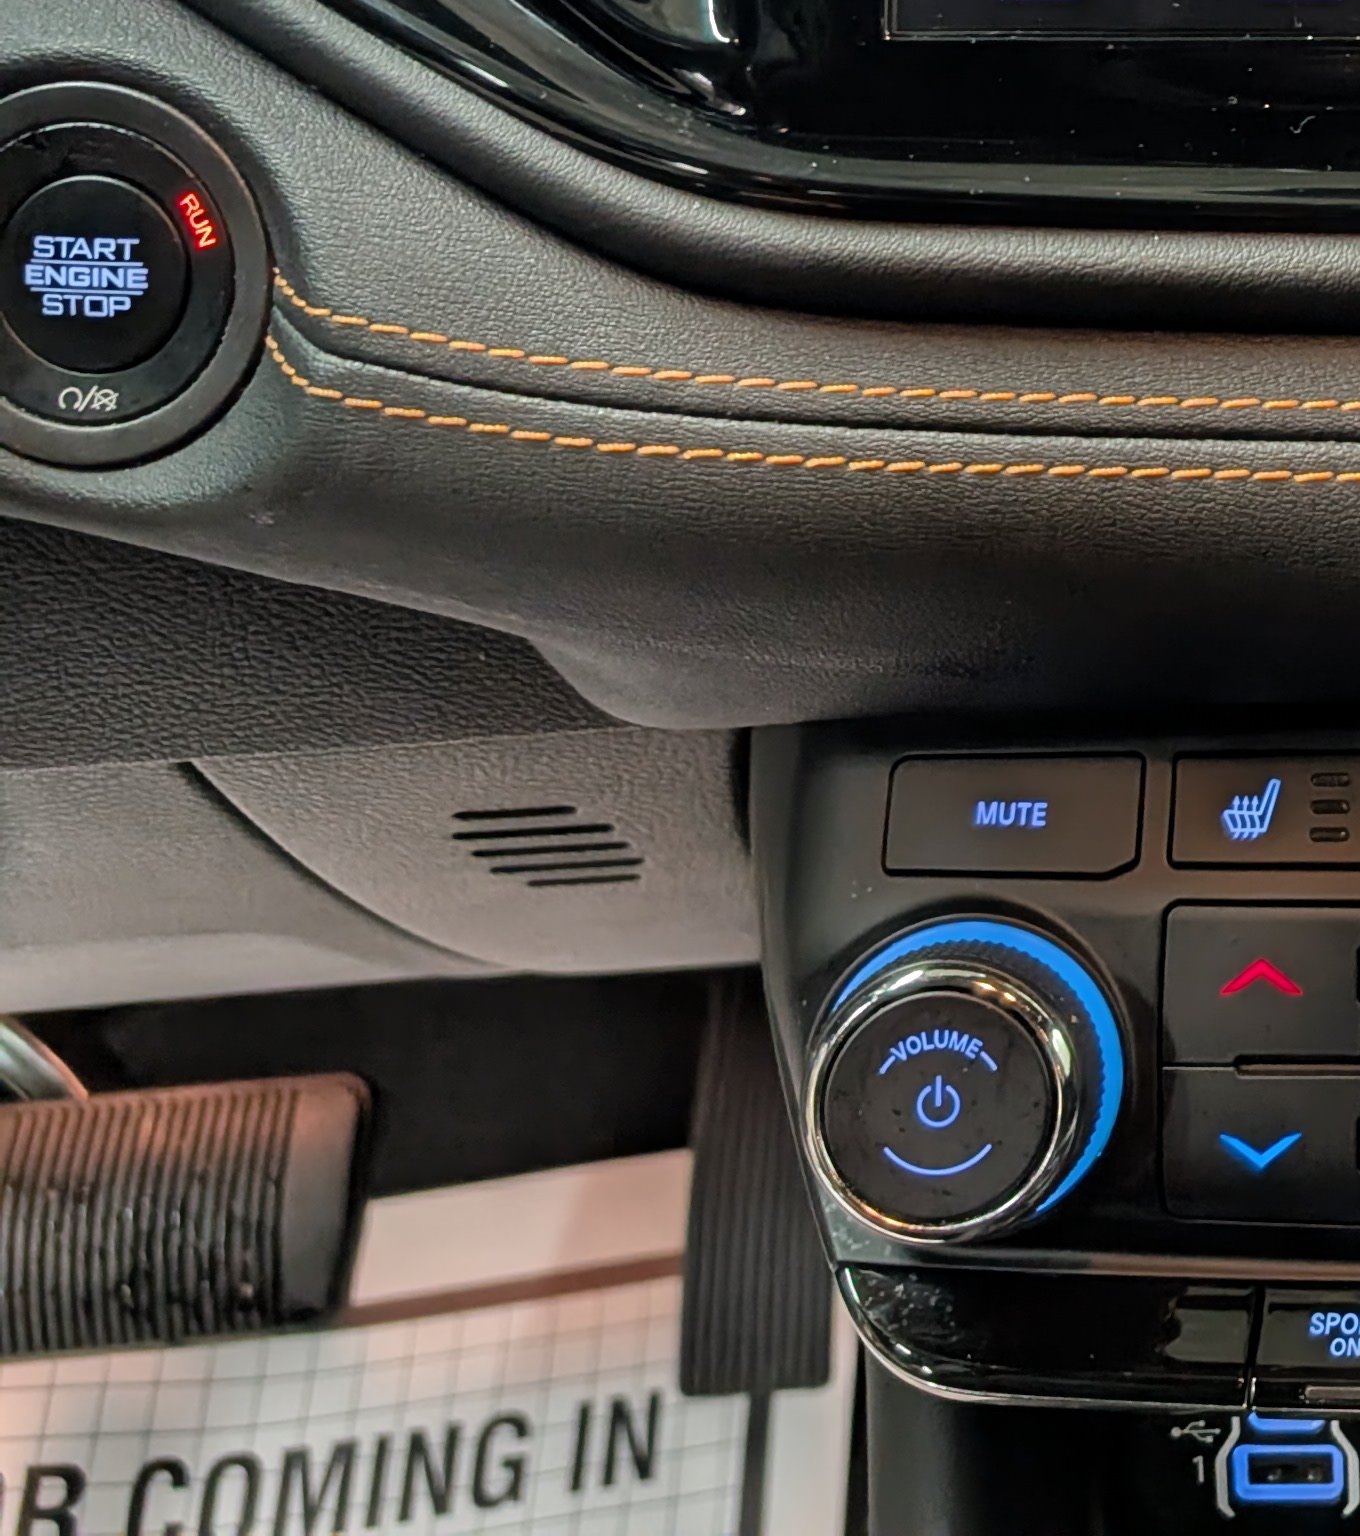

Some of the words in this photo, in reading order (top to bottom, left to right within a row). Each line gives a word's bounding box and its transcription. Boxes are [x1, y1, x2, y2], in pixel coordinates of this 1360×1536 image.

[177, 191, 216, 250] RUN
[33, 235, 140, 261] START
[24, 264, 149, 289] ENGINE
[41, 294, 132, 318] STOP
[974, 799, 1049, 829] MUTE
[890, 1029, 984, 1064] VOLUME
[122, 1412, 534, 1536] COMING
[567, 1389, 665, 1493] IN
[1192, 1456, 1205, 1483] 1
